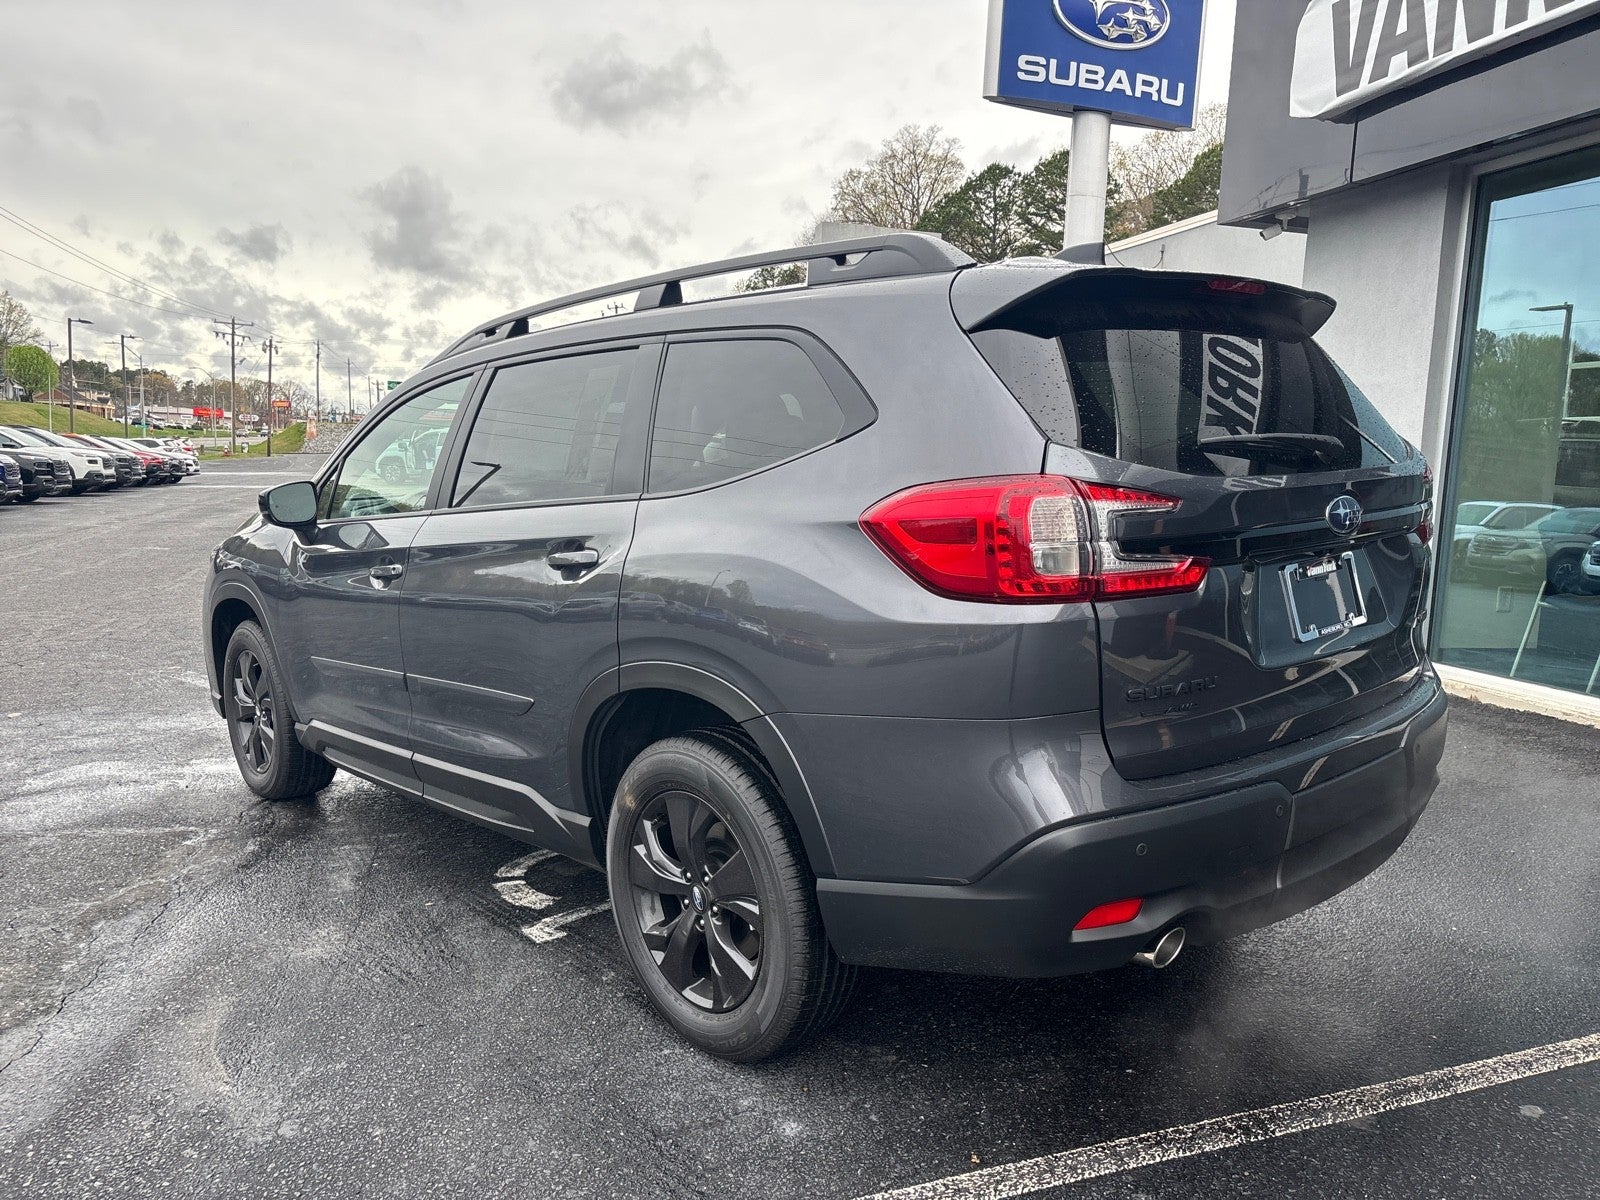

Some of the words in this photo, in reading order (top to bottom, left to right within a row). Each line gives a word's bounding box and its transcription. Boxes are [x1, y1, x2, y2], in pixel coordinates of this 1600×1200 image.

[1331, 0, 1575, 98] VAN
[1016, 54, 1185, 107] SUBARU
[1126, 677, 1218, 703] SUBARU
